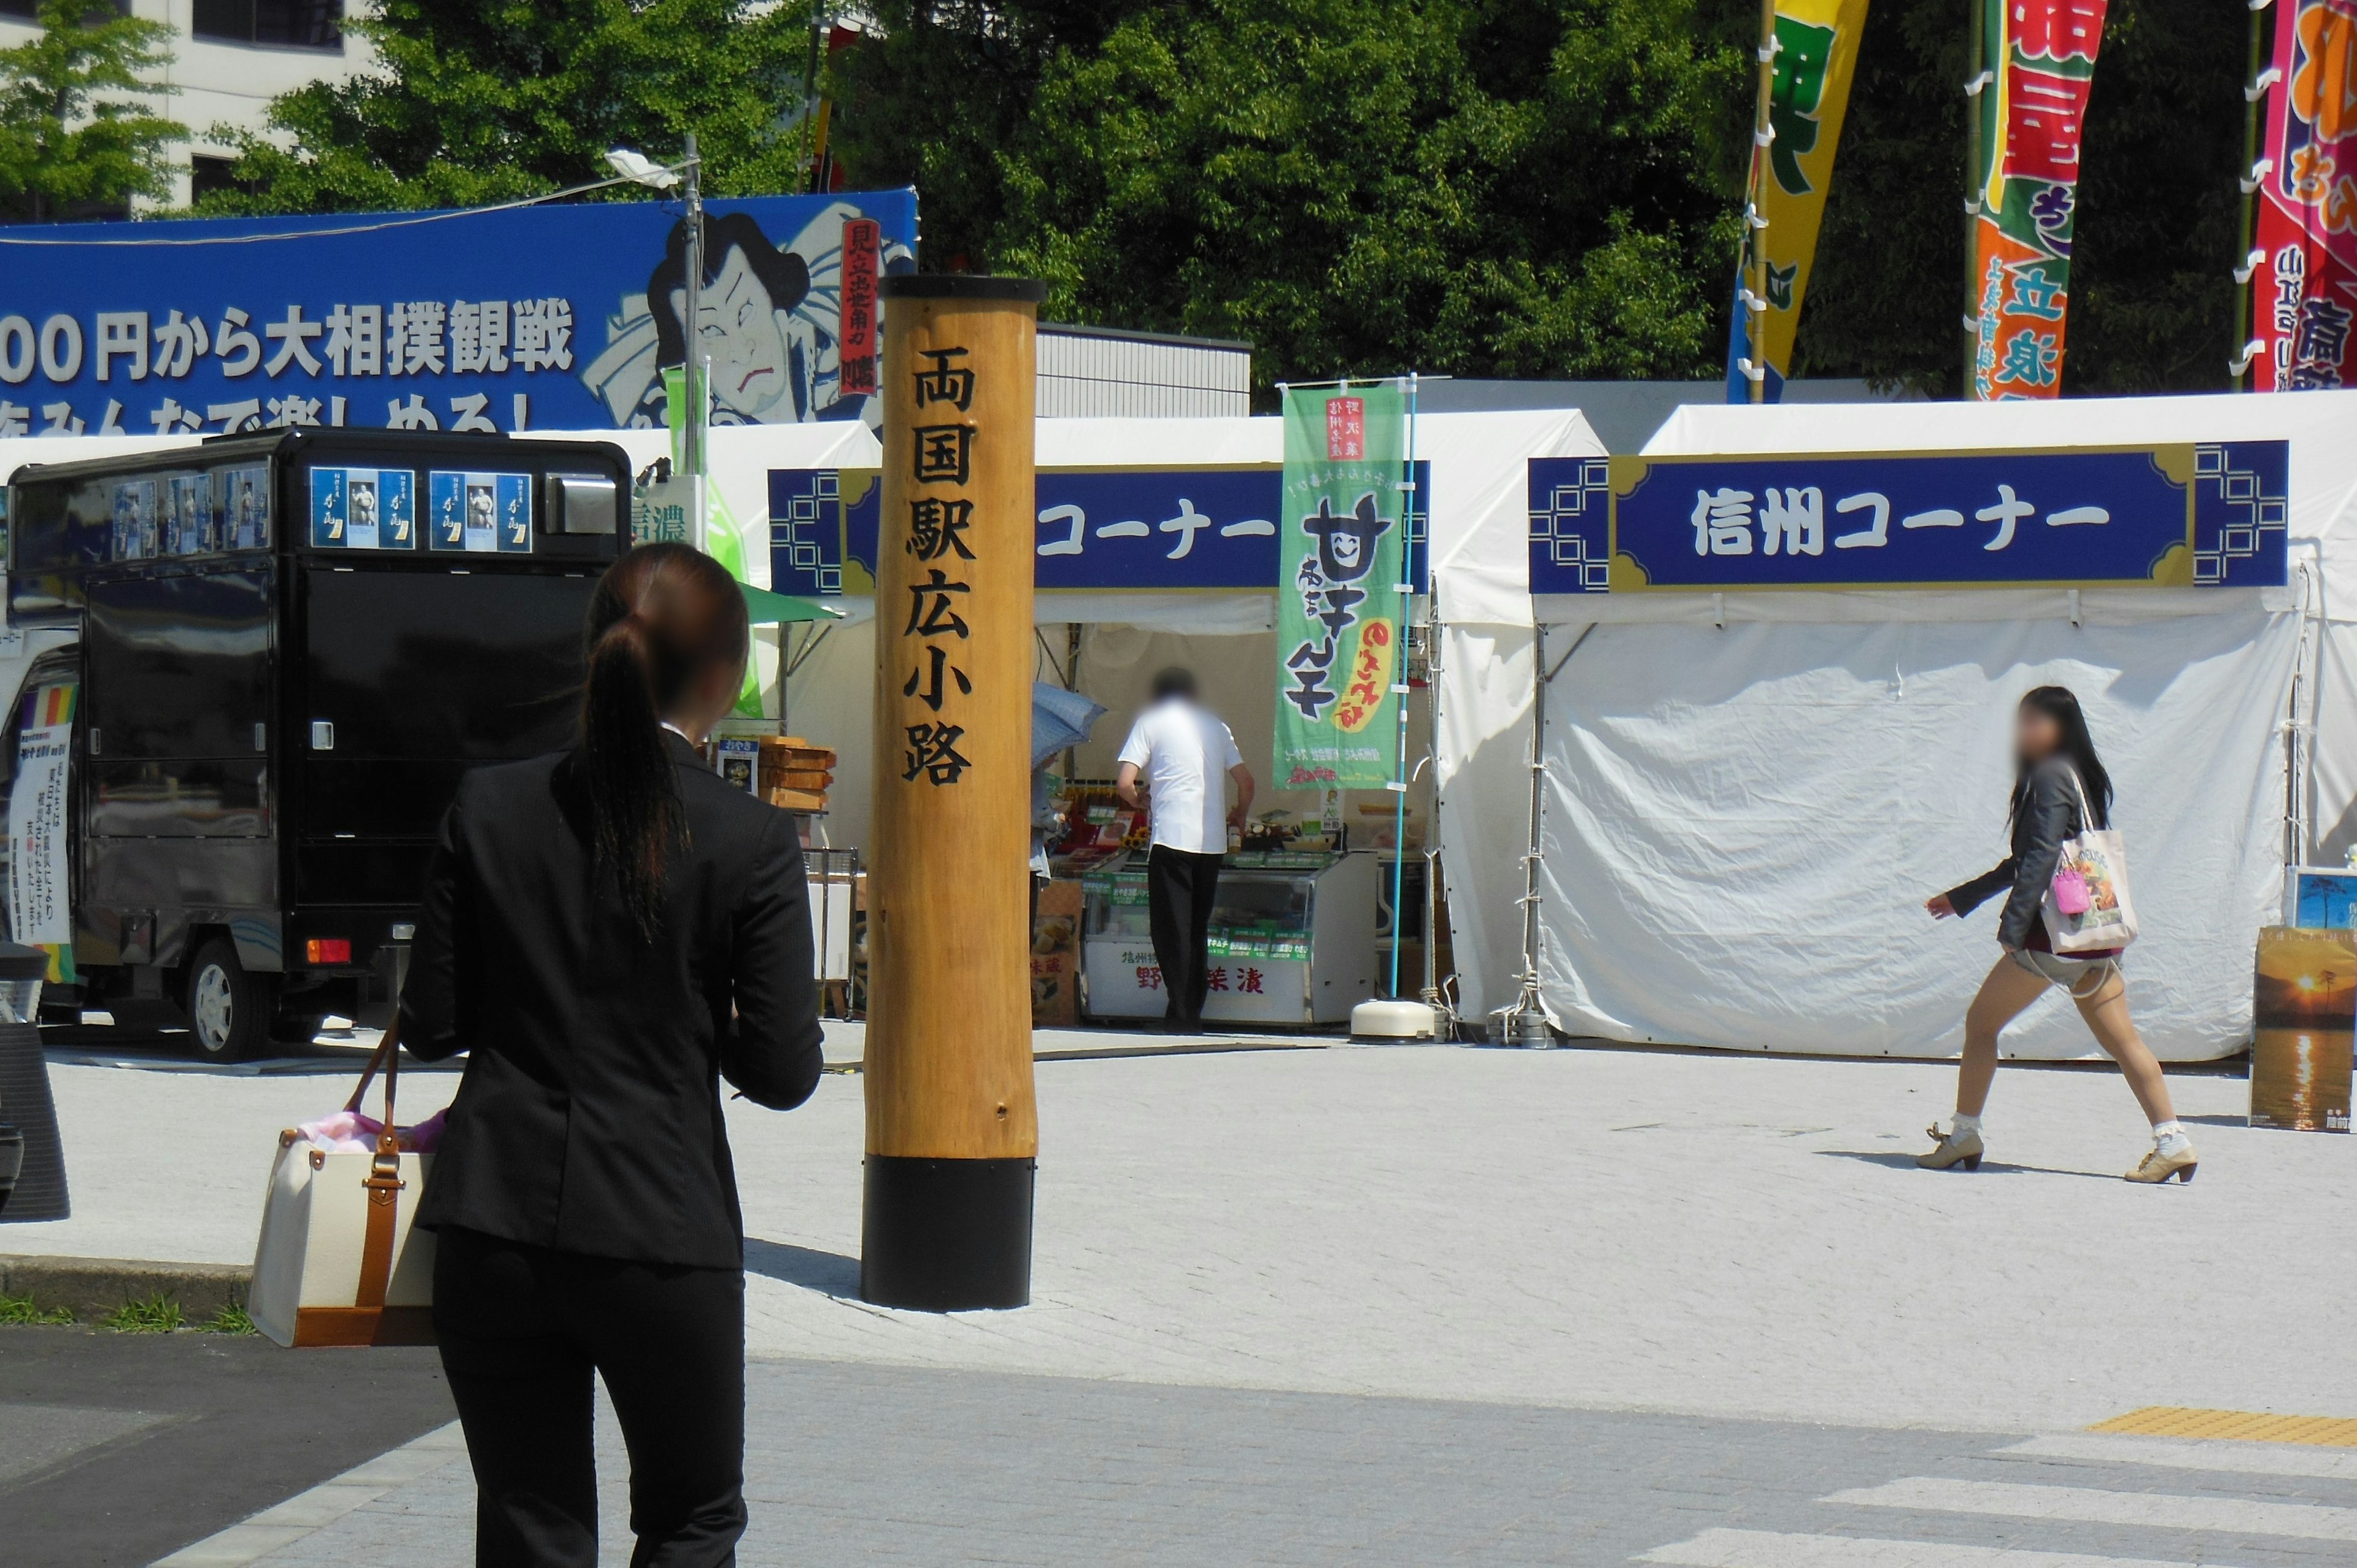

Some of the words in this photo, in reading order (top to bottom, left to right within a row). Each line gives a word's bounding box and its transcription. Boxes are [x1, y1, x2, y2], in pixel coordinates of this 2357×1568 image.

[0, 297, 573, 383] 00円から大相撲観戦
[1690, 483, 2111, 557] 信州コーナー
[901, 346, 977, 787] 両国駅広小路
[726, 740, 751, 751] おやき
[1122, 951, 1159, 964] 信州特
[1136, 965, 1264, 995] 野菜漬
[2326, 1116, 2351, 1130] 陸前
